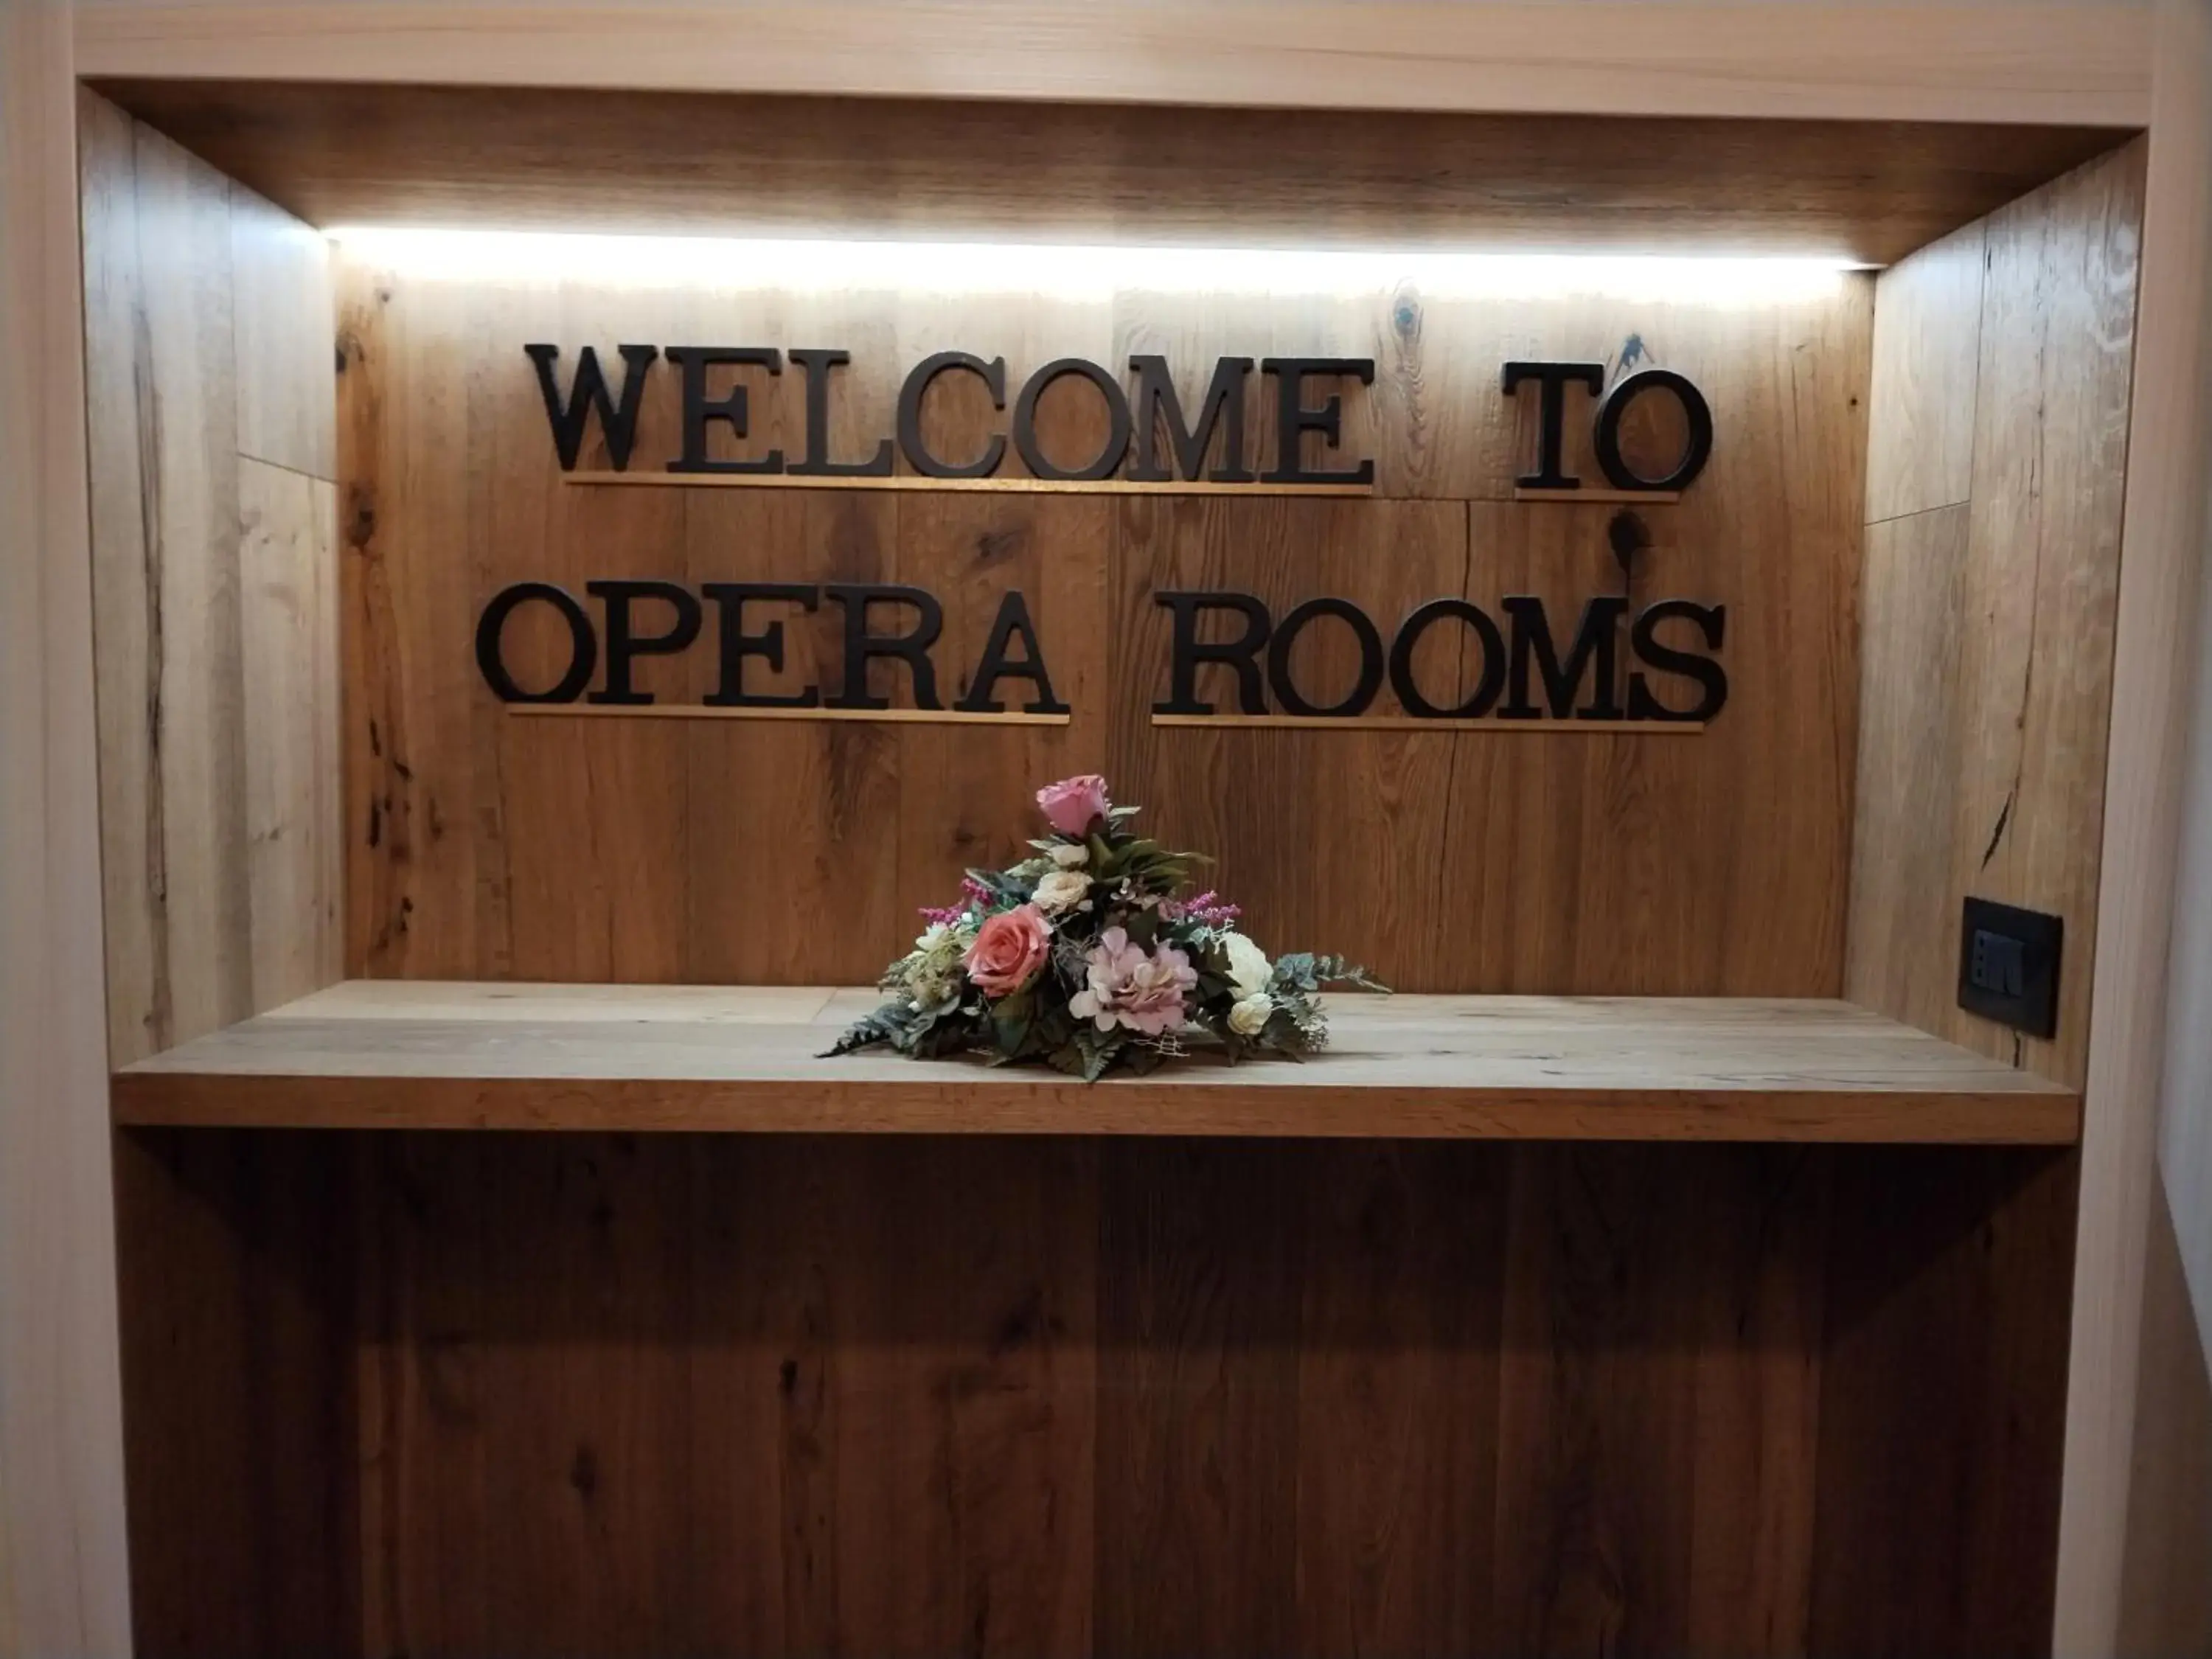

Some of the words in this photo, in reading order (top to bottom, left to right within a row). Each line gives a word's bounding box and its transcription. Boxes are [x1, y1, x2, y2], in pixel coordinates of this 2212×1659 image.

[525, 343, 1374, 484] WELCOME
[1503, 361, 1713, 491] TO
[476, 581, 1071, 713] OPERA
[1152, 592, 1727, 720] ROOMS
